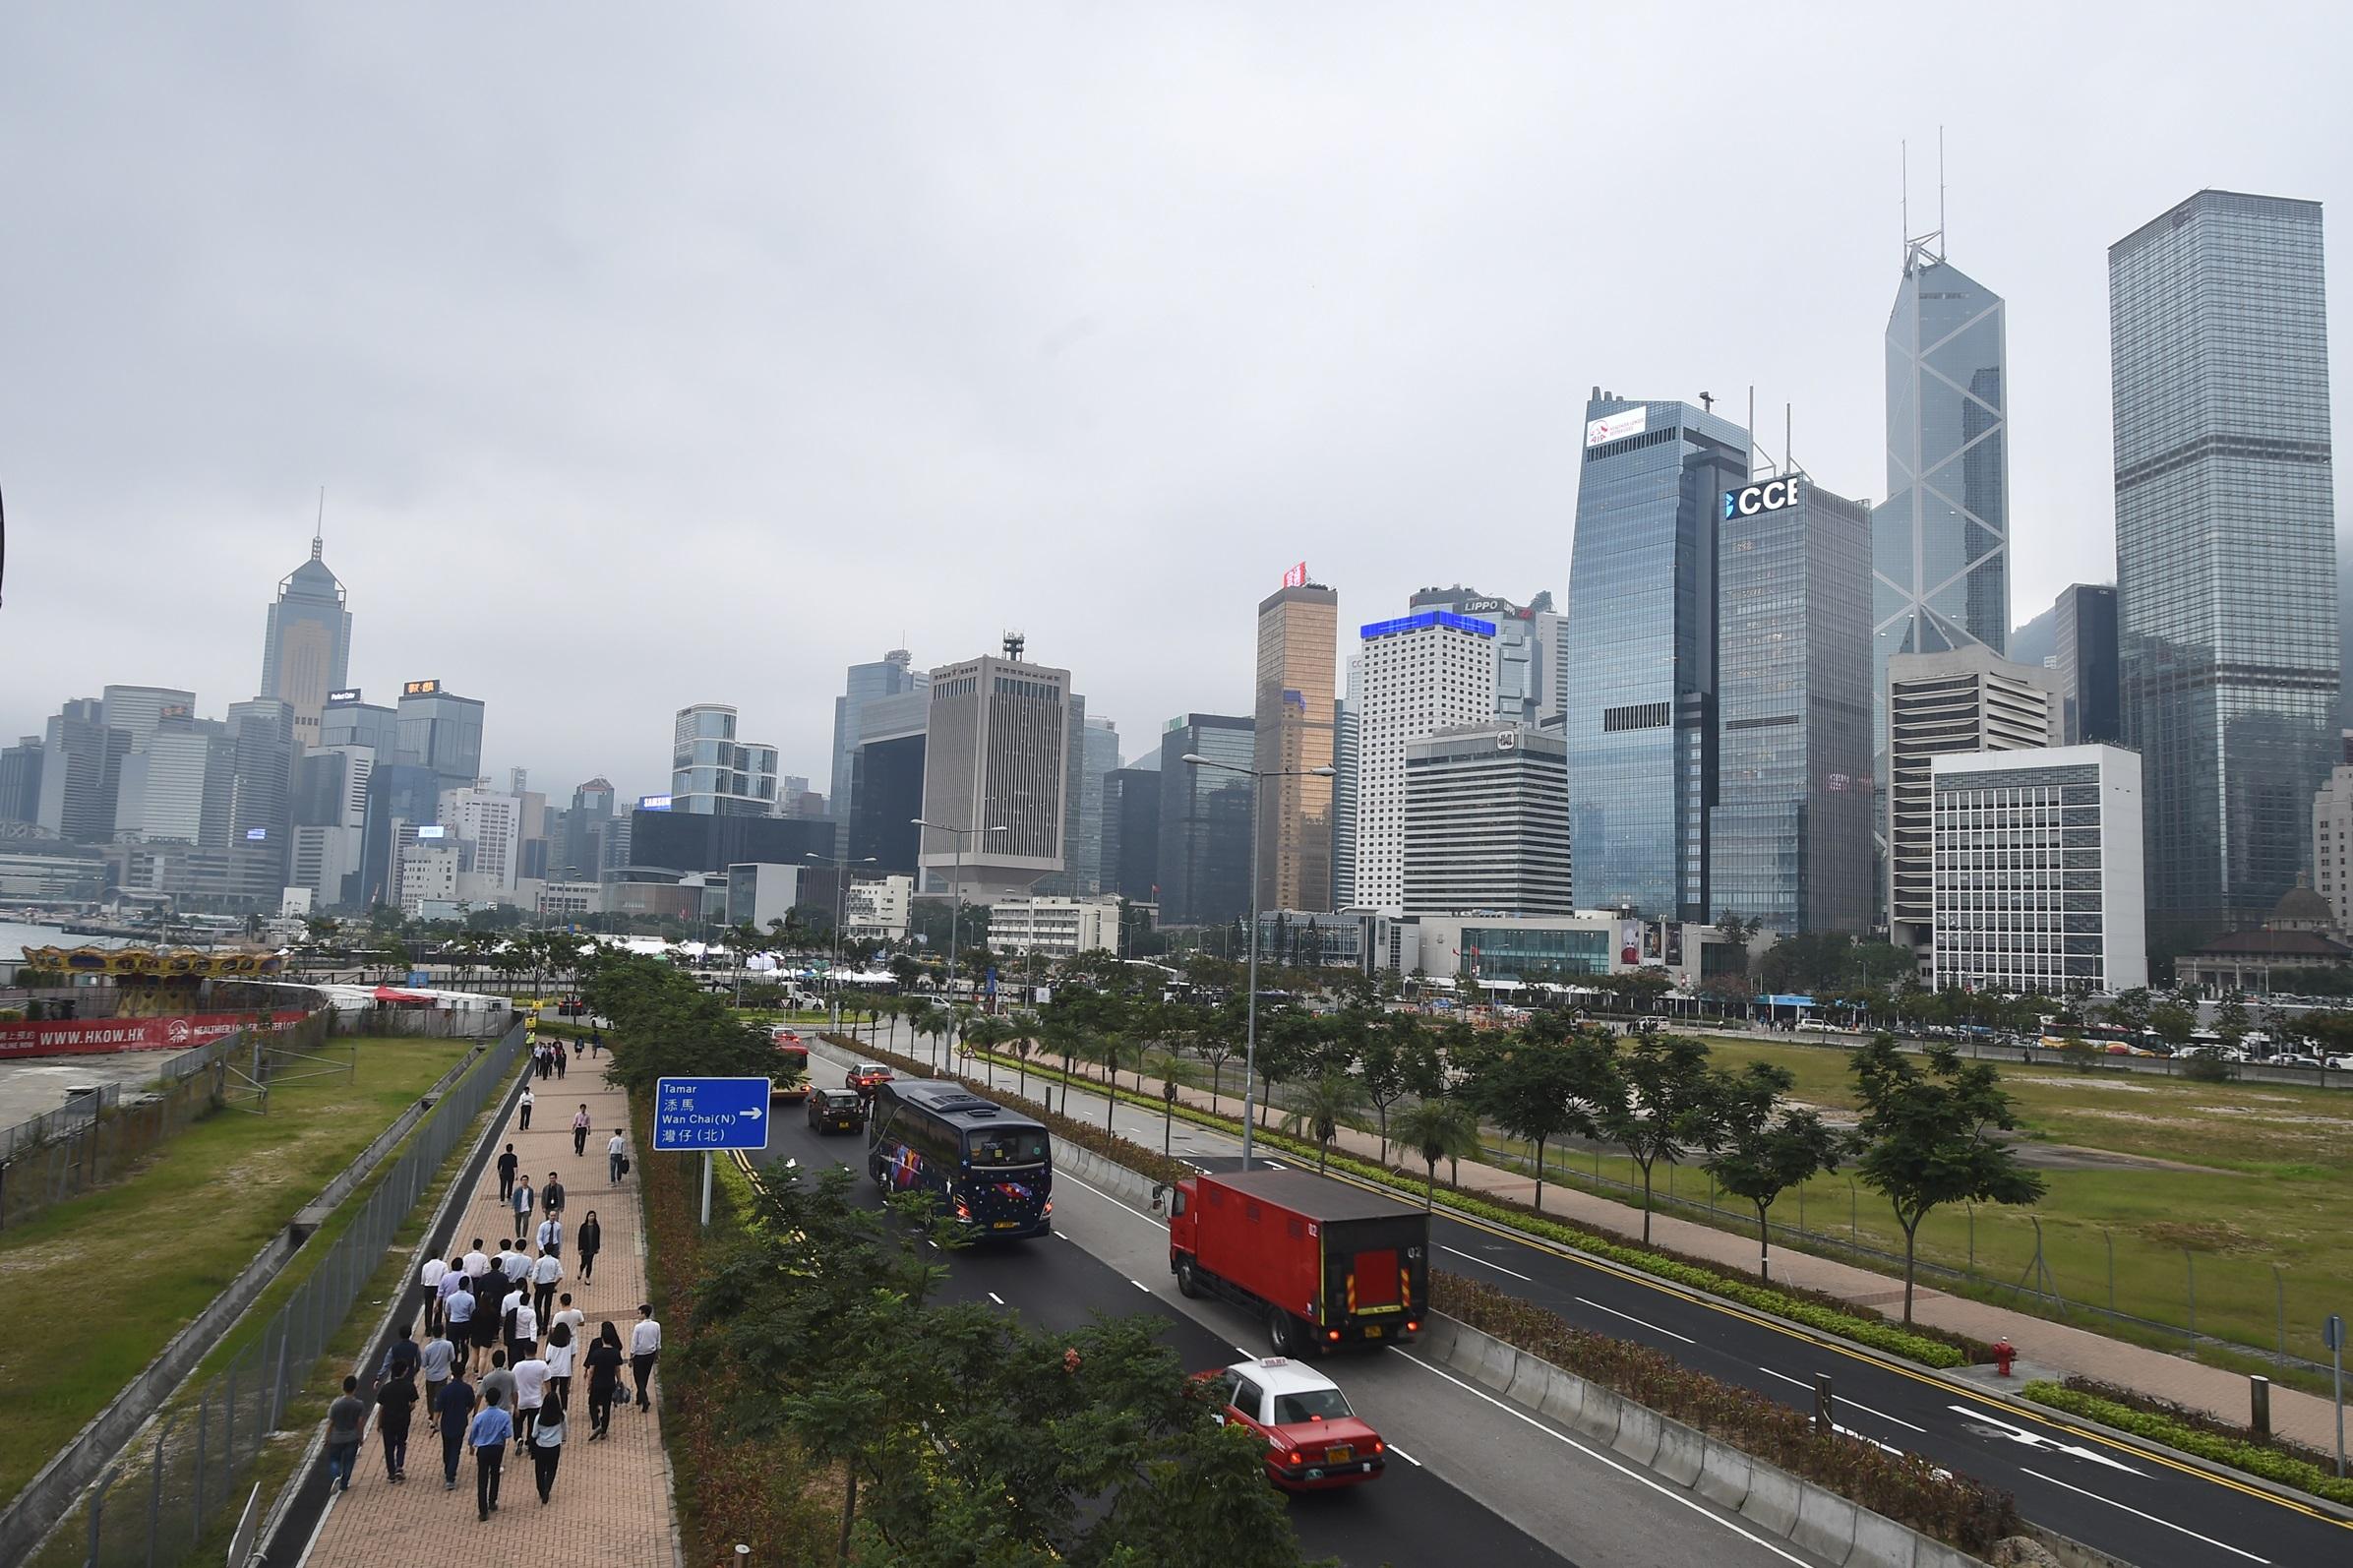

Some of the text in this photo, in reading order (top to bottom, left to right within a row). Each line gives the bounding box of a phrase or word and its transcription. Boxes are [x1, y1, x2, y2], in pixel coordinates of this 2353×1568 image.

[1465, 600, 1497, 611] LIPPO
[40, 1028, 145, 1046] WWW.HKOW.HK
[664, 1084, 696, 1094] Tamar
[664, 1098, 694, 1112] 添馬
[662, 1115, 736, 1125] Wan Chai(N)
[662, 1129, 725, 1142] 灣仔(北)
